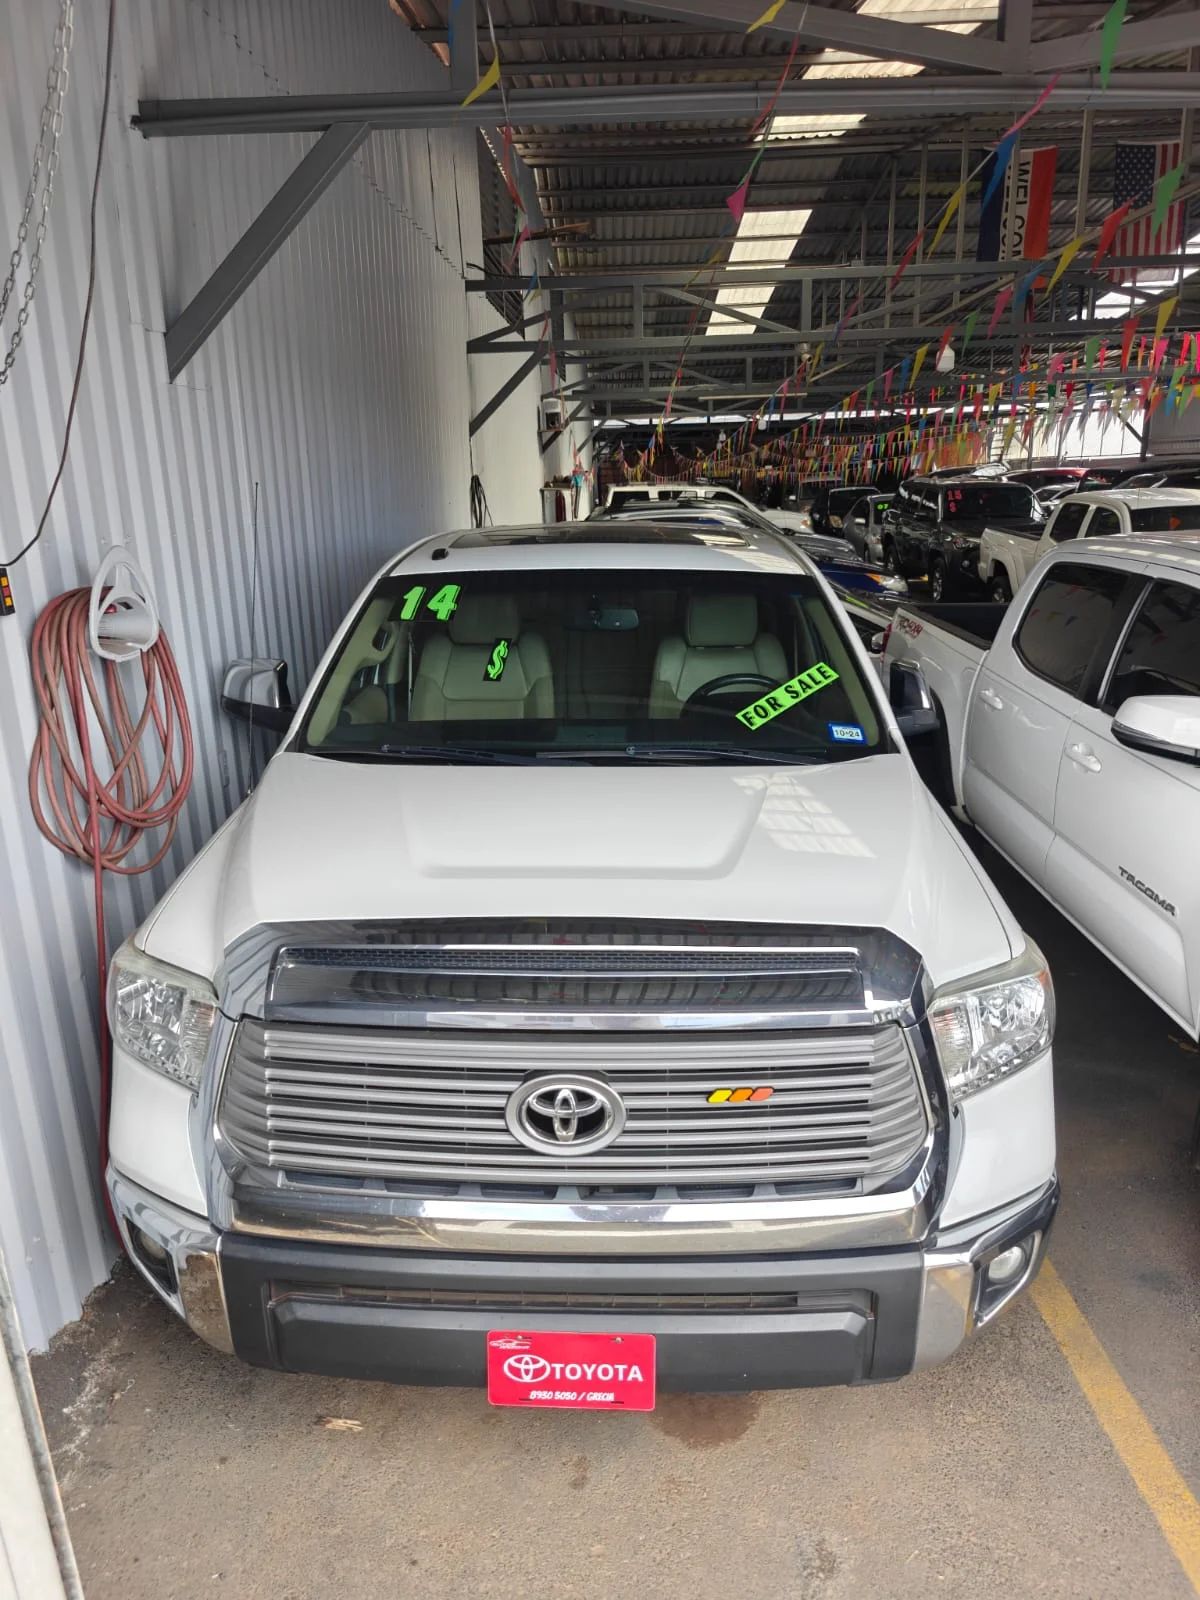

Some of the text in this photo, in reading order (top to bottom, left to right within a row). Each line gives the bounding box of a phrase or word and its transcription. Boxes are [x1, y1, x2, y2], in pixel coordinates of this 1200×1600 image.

[400, 584, 461, 620] 14
[487, 640, 508, 679] $
[741, 665, 832, 727] FOR SALE
[1118, 865, 1175, 916] TACOMA
[551, 1363, 643, 1382] TOYOTA
